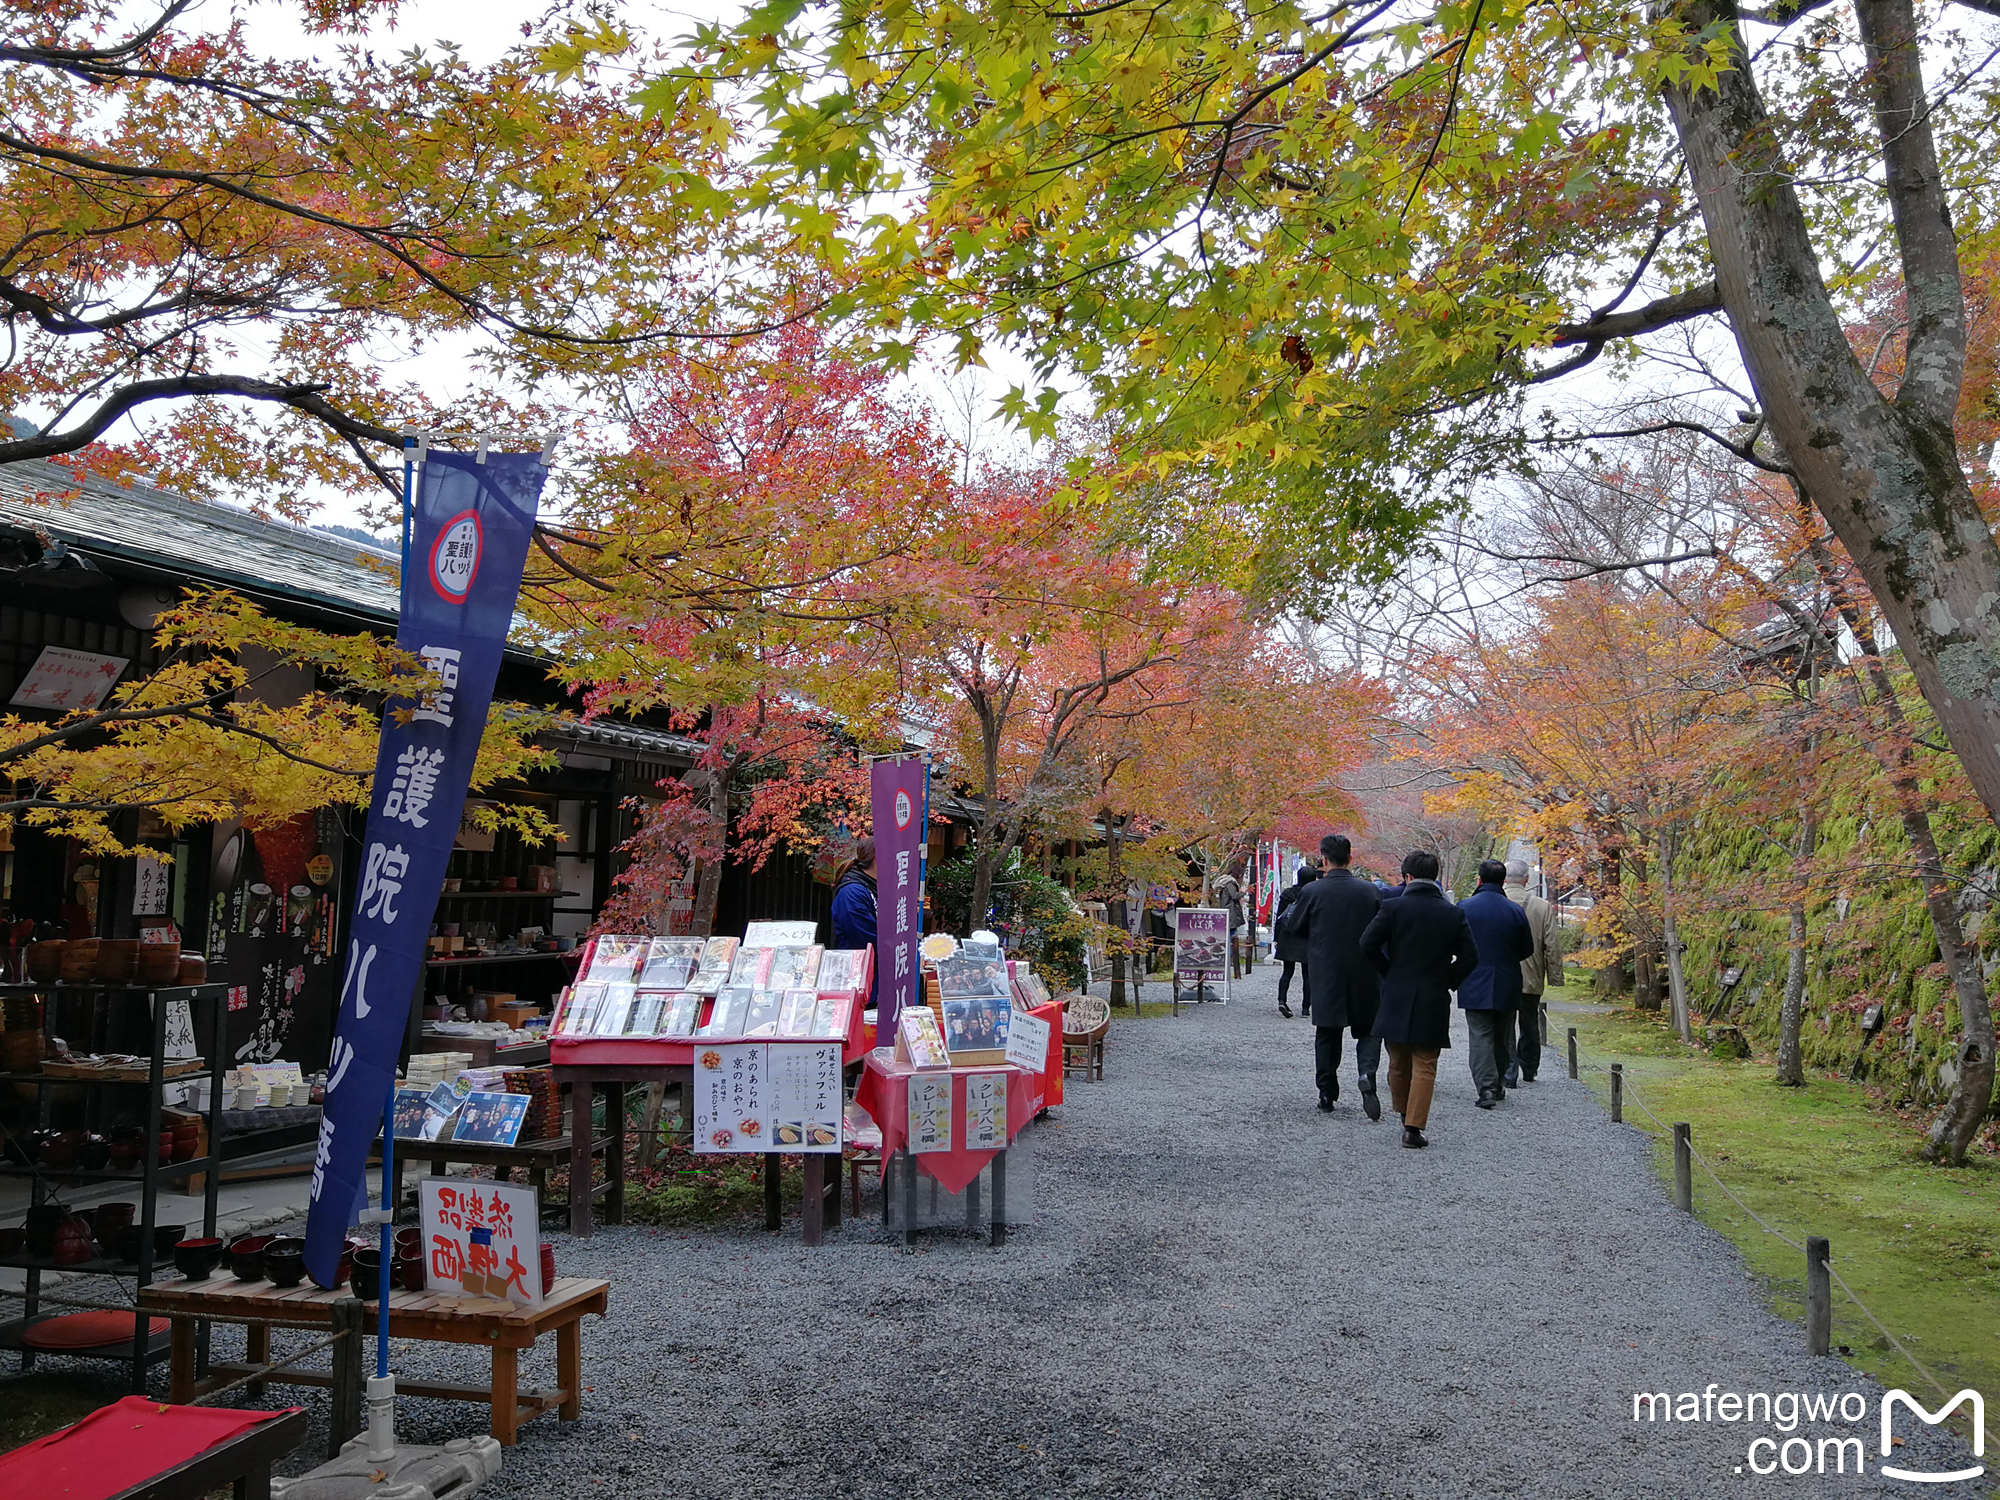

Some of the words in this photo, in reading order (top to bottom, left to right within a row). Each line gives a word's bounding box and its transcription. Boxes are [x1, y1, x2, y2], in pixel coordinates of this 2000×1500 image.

[139, 867, 152, 914] あります
[1189, 919, 1214, 930] しば漬
[733, 1057, 744, 1116] 京のおやつ
[748, 1049, 759, 1109] 京のあられ
[920, 1085, 936, 1143] クレープ八つ橋
[979, 1083, 994, 1142] クレープ八つ橋
